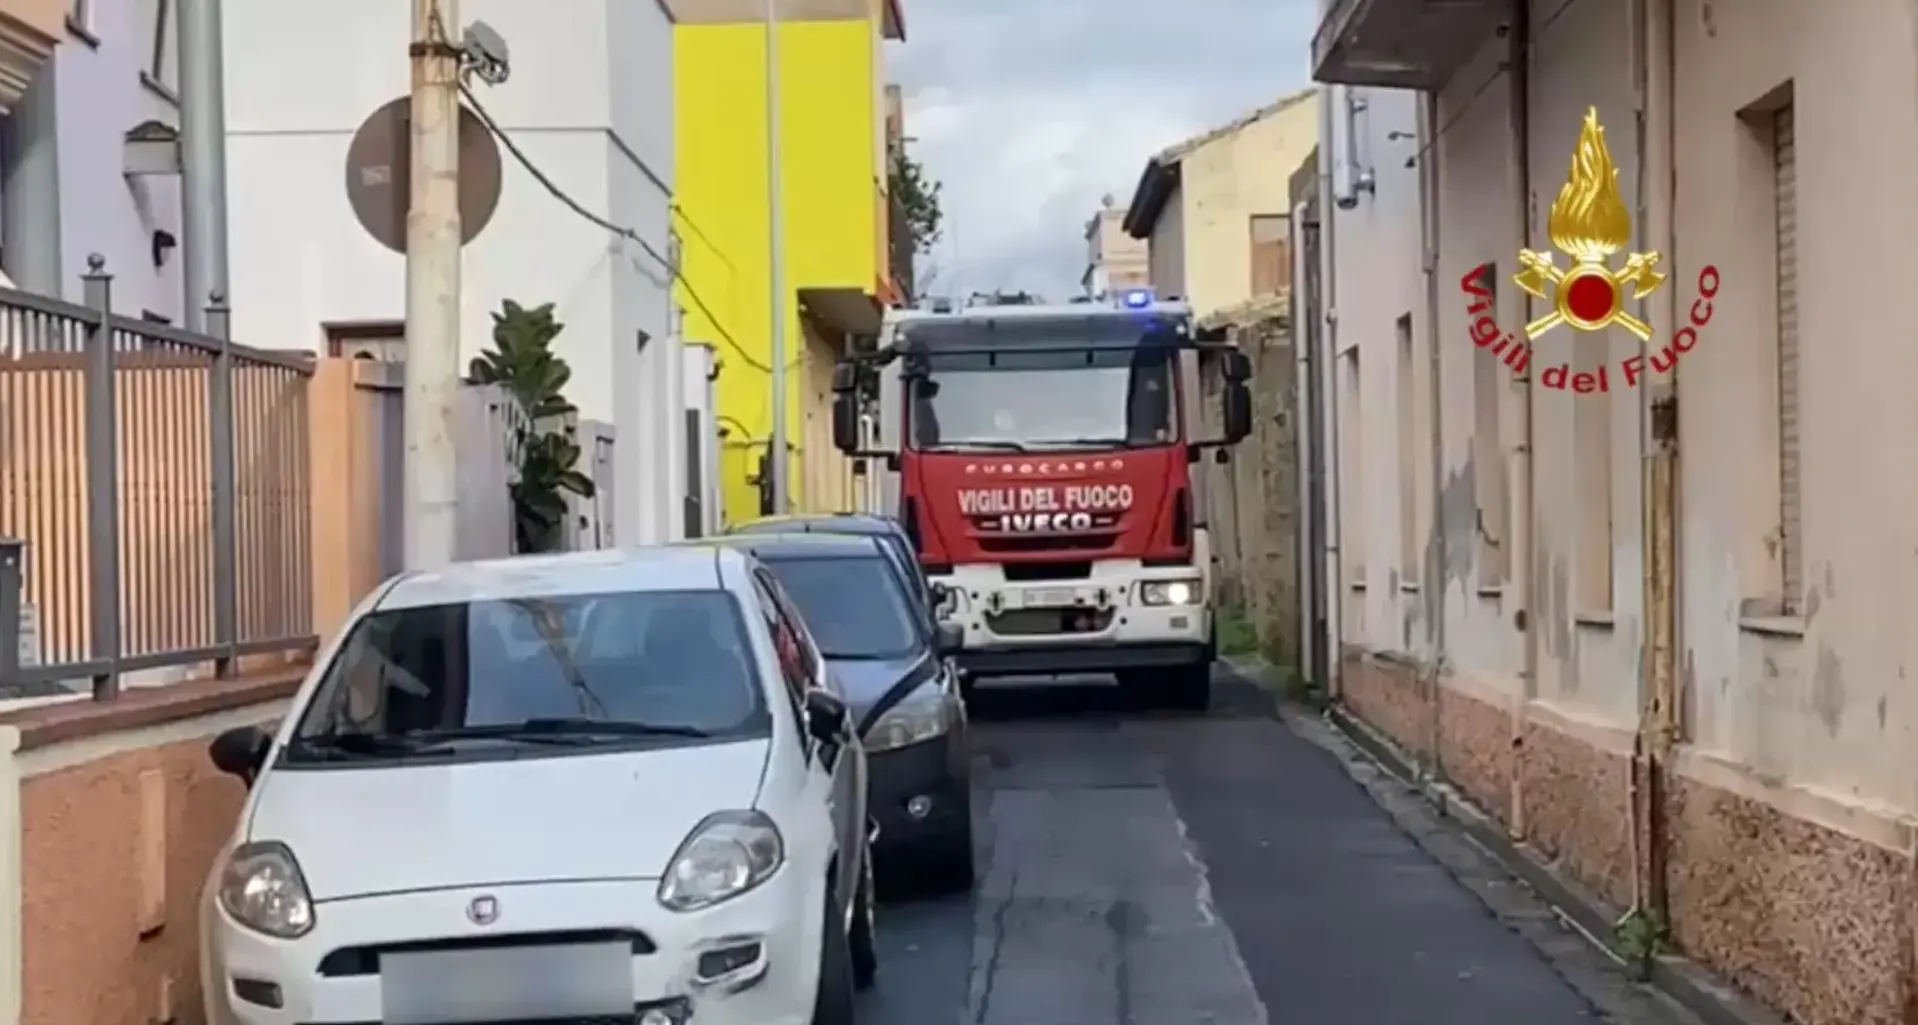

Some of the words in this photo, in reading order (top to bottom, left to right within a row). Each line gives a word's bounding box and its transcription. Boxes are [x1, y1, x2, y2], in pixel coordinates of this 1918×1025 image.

[957, 488, 1015, 513] VIGILI
[1020, 487, 1059, 510] DEL
[1065, 484, 1133, 509] FUOCO
[1001, 512, 1092, 533] IVECO
